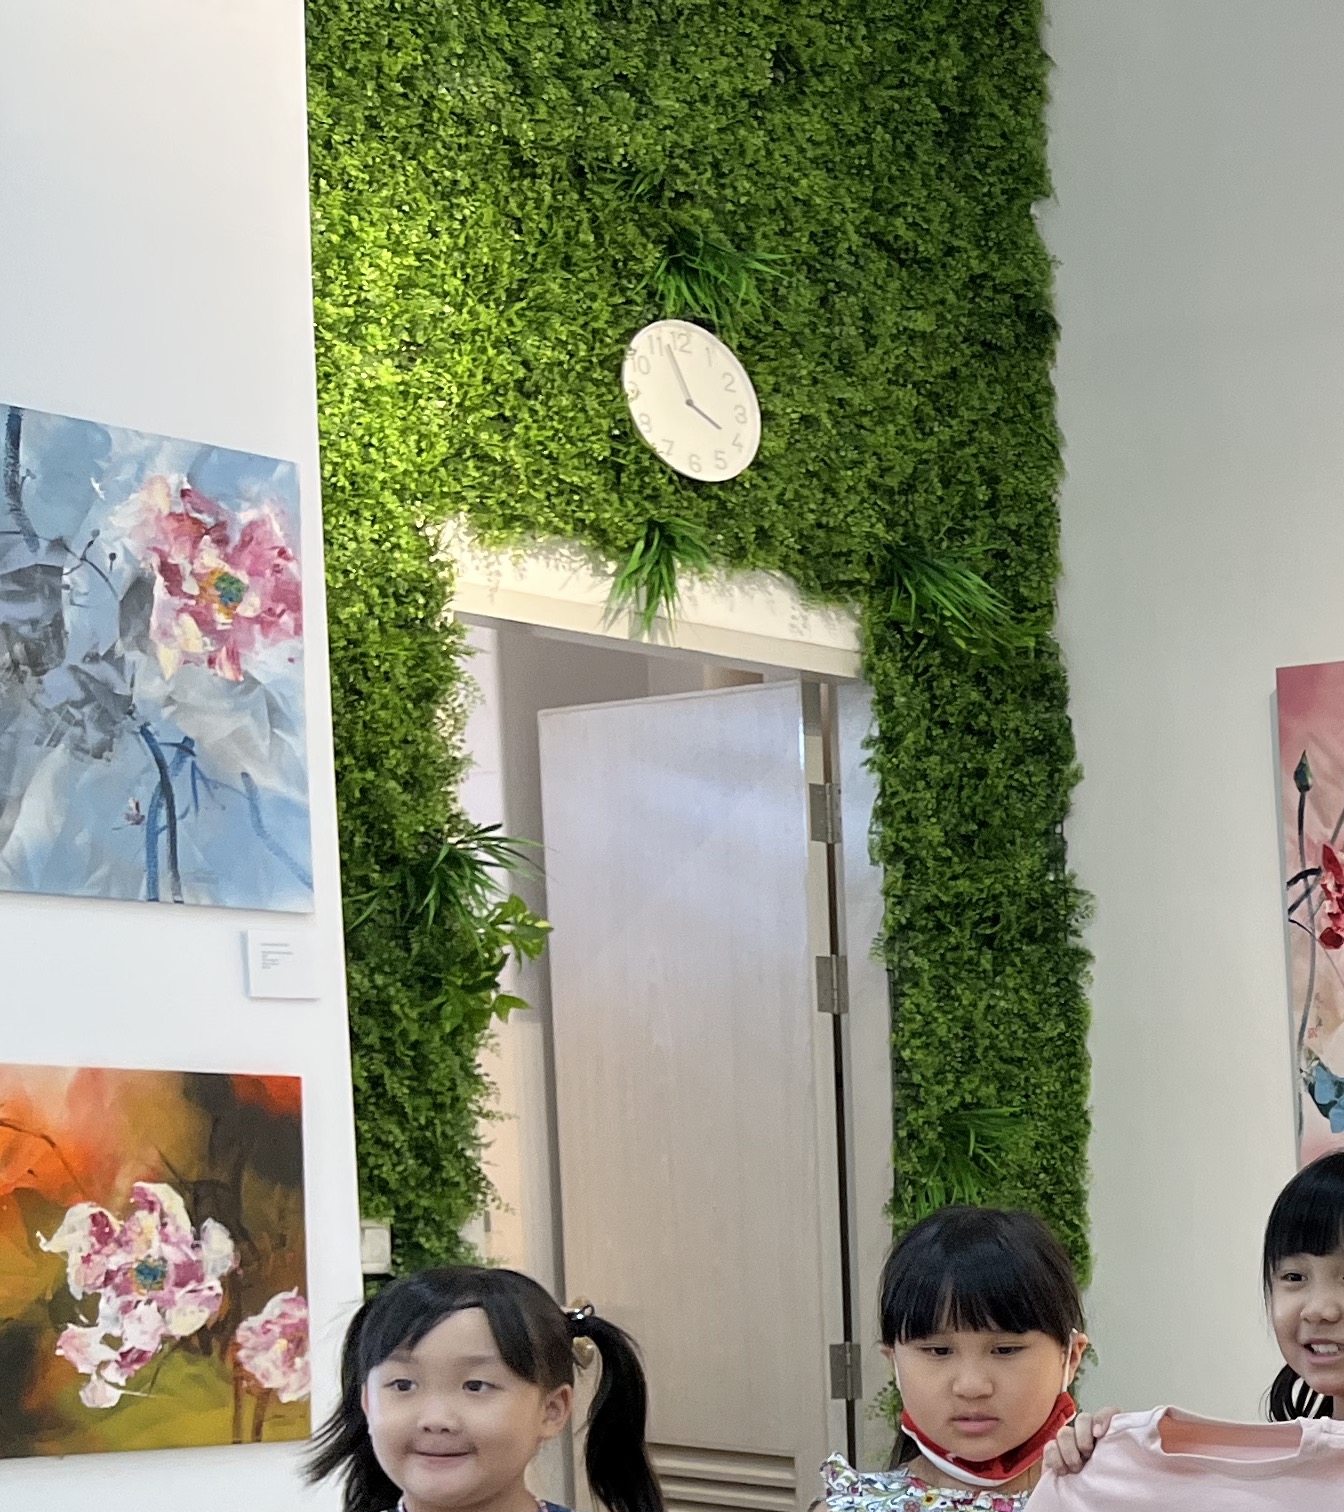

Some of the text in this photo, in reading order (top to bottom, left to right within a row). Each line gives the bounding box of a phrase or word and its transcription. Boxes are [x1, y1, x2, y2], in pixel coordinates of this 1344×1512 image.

[648, 334, 664, 356] 11
[670, 331, 692, 354] 12
[722, 372, 736, 393] 2
[638, 412, 652, 433] 8
[733, 404, 748, 424] 3
[661, 438, 675, 457] 7
[731, 433, 744, 453] 4
[688, 453, 703, 473] 6
[713, 450, 728, 470] 5
